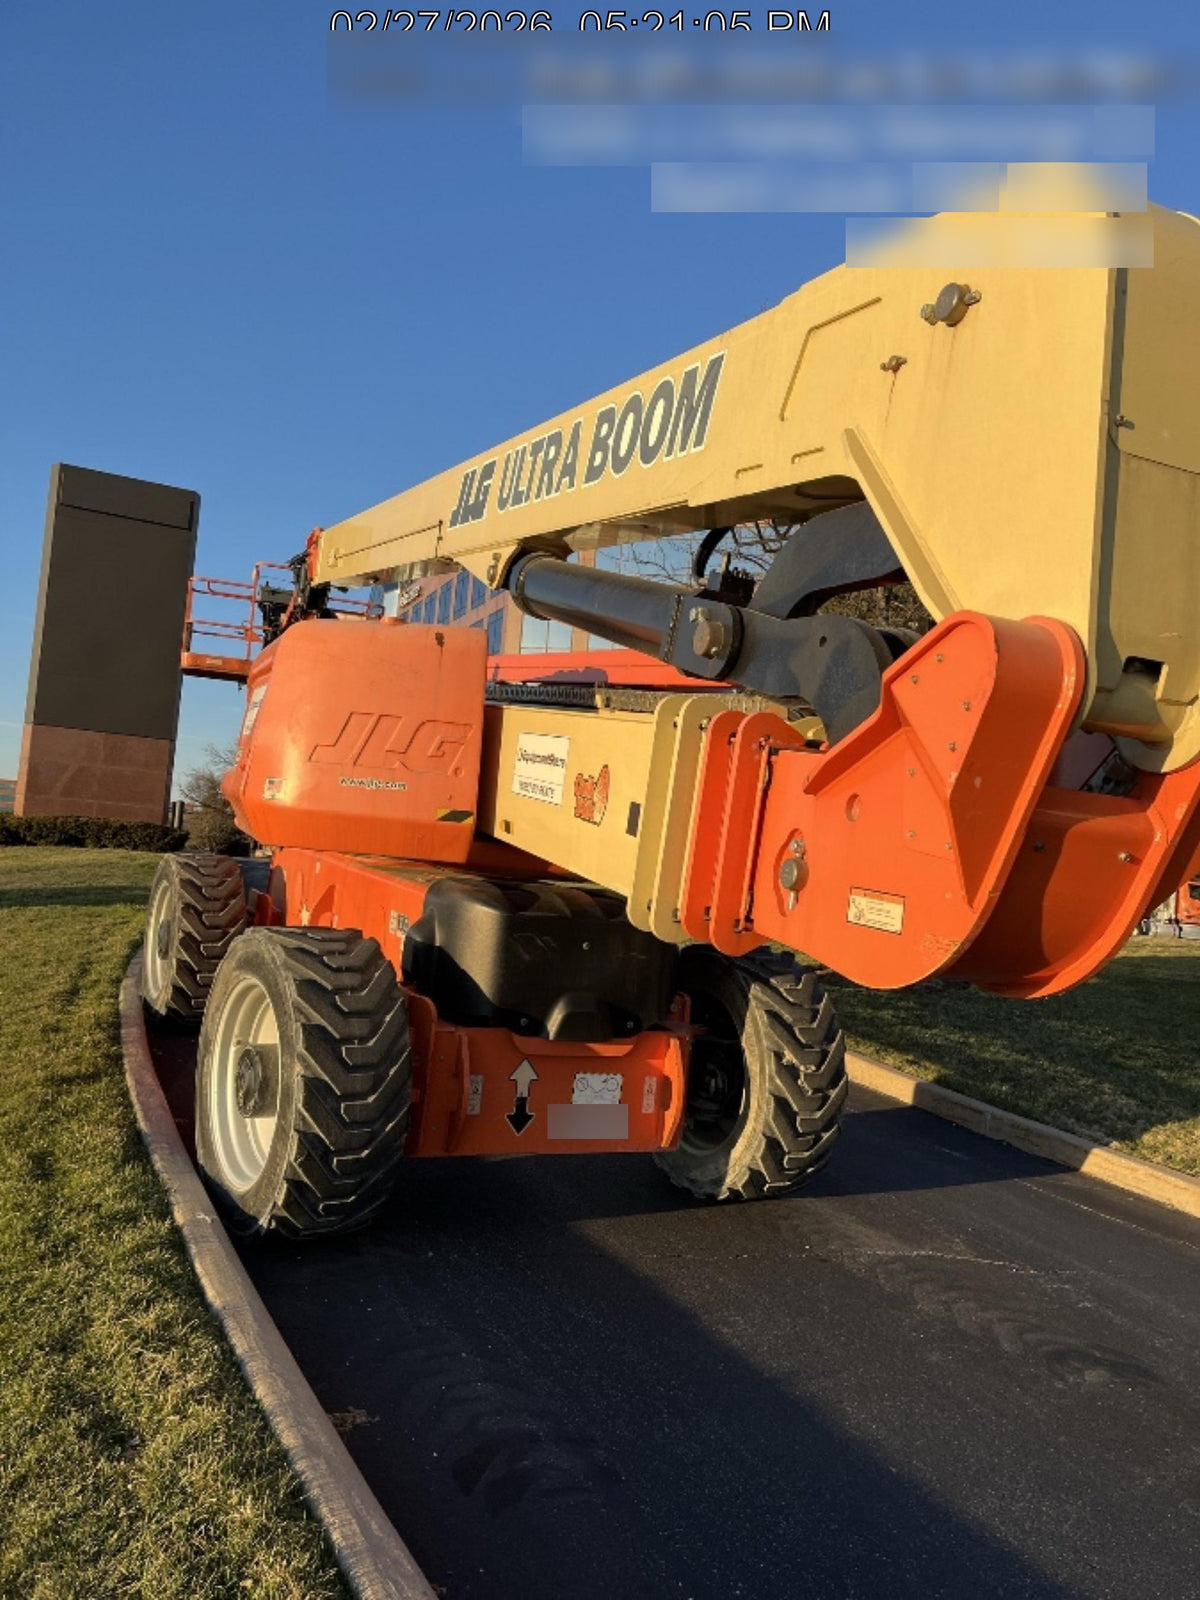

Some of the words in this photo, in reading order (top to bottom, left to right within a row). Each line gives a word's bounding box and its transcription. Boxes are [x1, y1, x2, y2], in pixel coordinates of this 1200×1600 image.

[449, 458, 498, 530] JLG
[497, 418, 583, 513] ULTRA
[582, 350, 727, 488] BOOM
[308, 711, 474, 776] JLG
[339, 777, 408, 791] www.jlg.com
